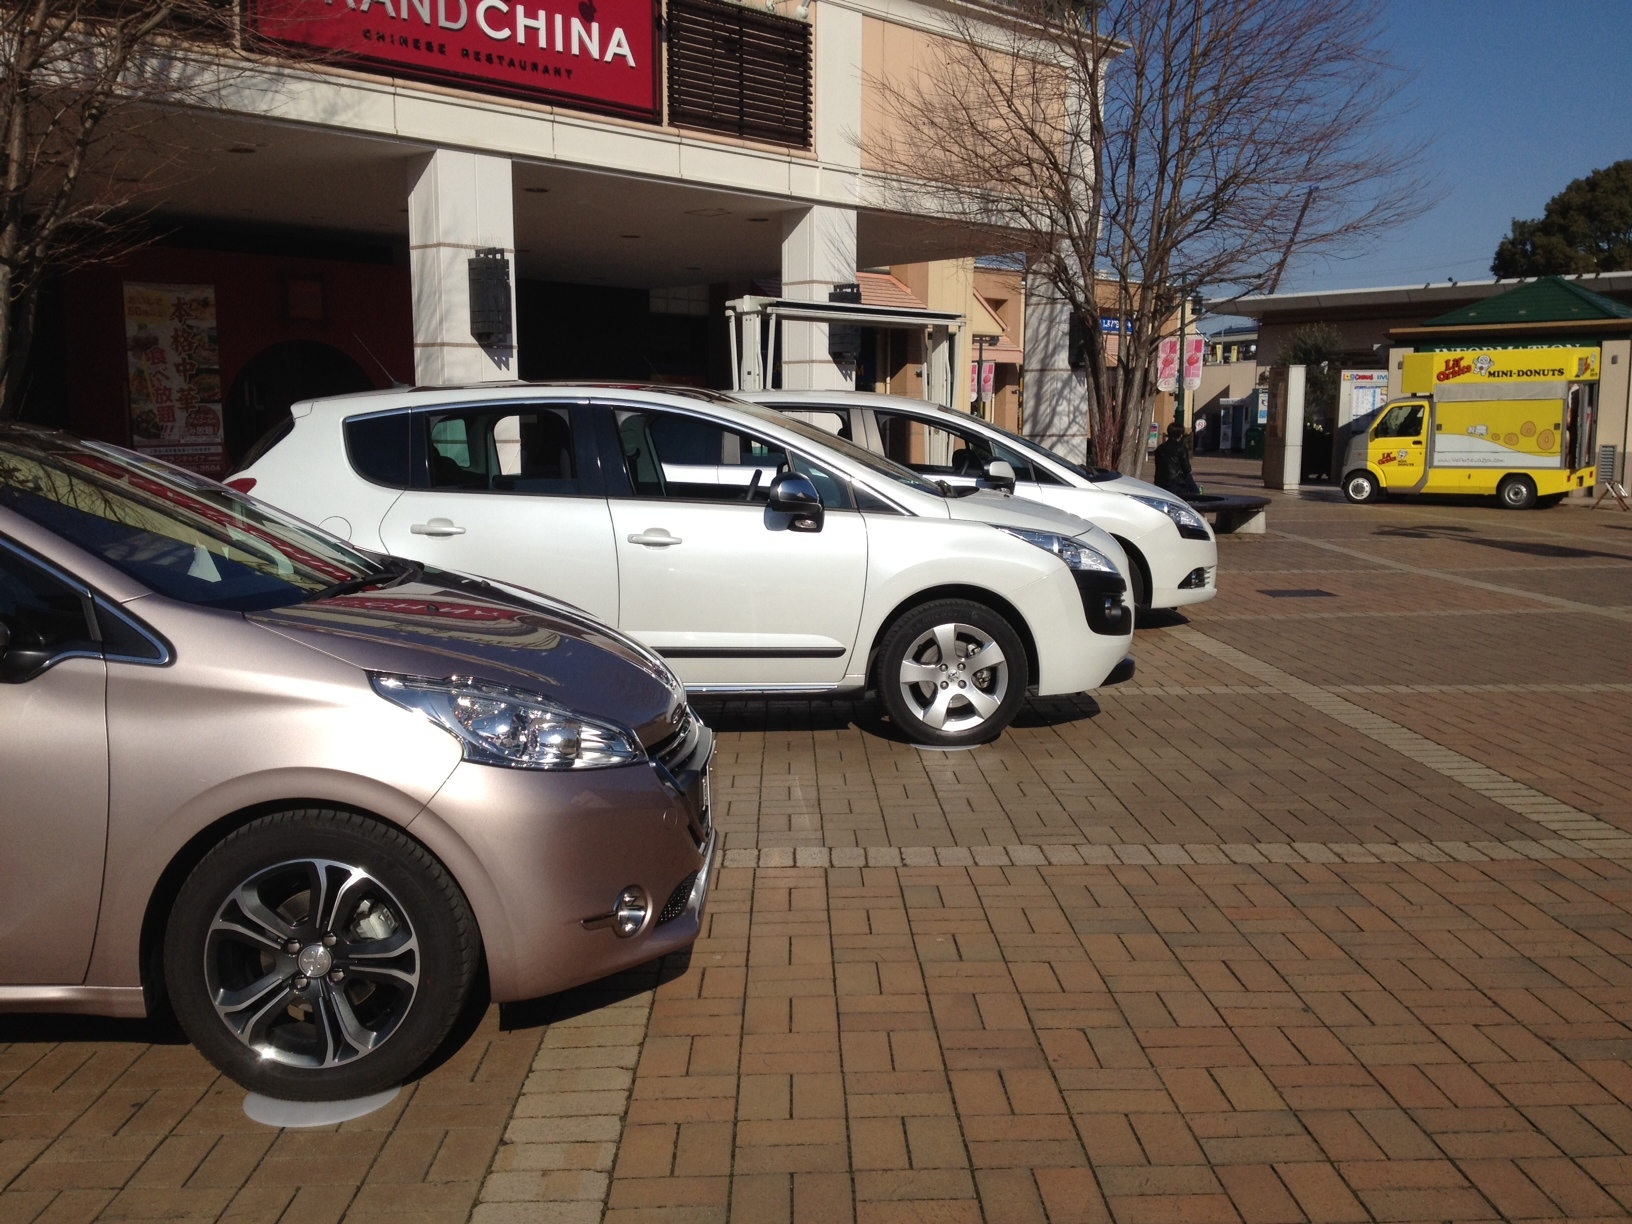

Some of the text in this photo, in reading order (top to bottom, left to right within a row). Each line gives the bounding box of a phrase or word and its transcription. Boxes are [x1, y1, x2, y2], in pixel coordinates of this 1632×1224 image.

[362, 28, 574, 79] CHINESE RESTAURANT
[169, 296, 199, 415] 本格中華
